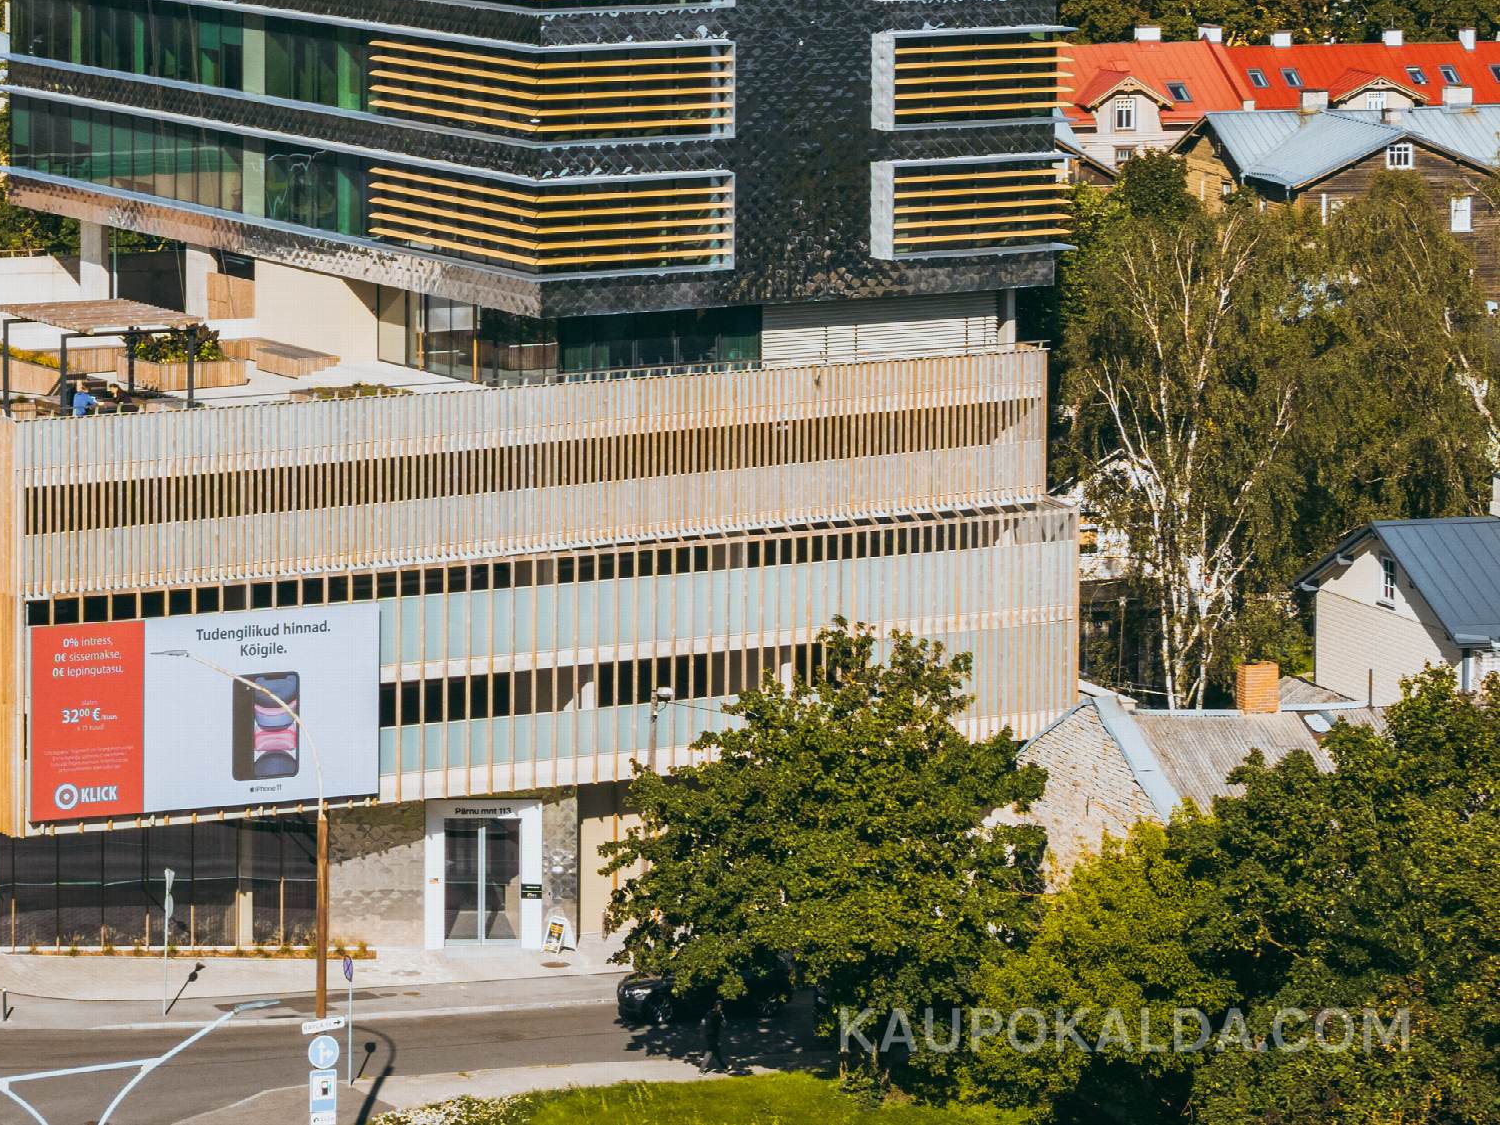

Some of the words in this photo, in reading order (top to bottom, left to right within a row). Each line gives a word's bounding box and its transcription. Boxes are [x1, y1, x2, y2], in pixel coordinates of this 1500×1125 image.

[196, 623, 280, 641] Tudengilikud
[283, 619, 331, 636] hinnad.
[62, 637, 79, 648] 0%
[240, 642, 288, 658] Kõigile.
[54, 652, 67, 663] 0€
[52, 667, 65, 677] 0€
[81, 786, 118, 803] KLICK
